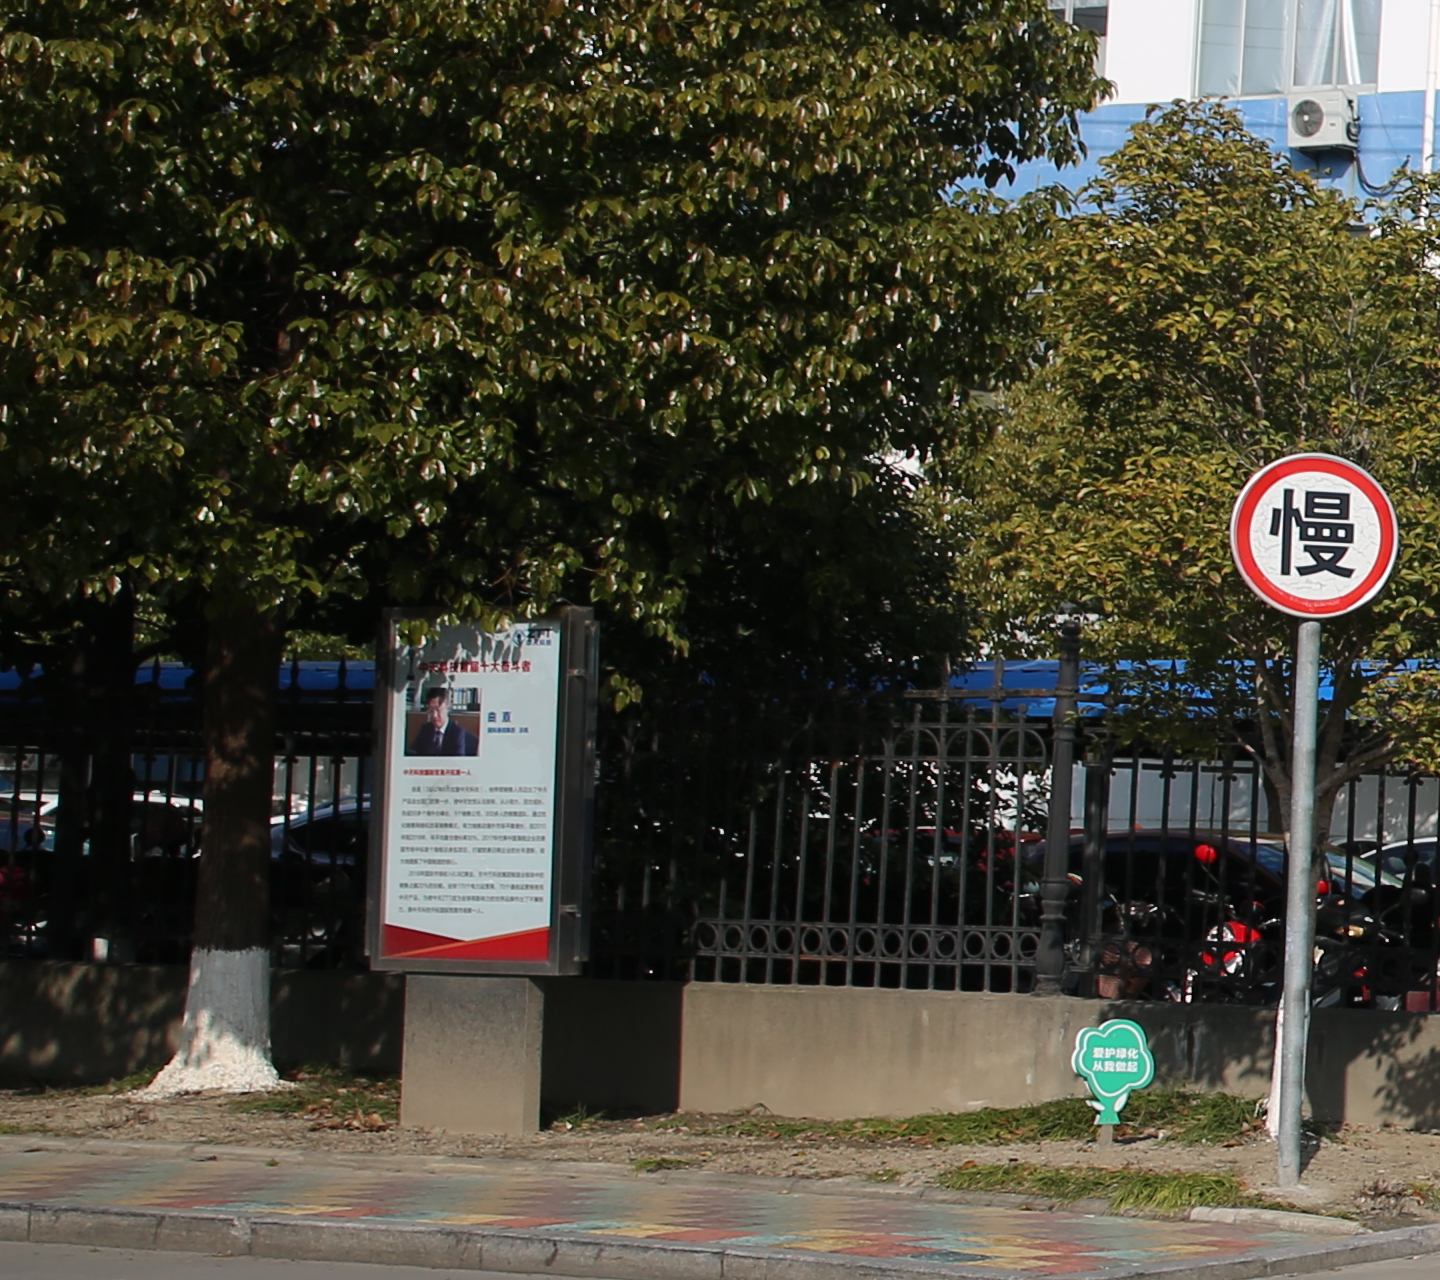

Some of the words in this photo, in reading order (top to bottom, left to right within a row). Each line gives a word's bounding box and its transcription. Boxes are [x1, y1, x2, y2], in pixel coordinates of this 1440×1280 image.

[1268, 487, 1356, 580] 慢
[1092, 1046, 1139, 1060] 爱护绿化
[1092, 1060, 1139, 1073] 从我做起
